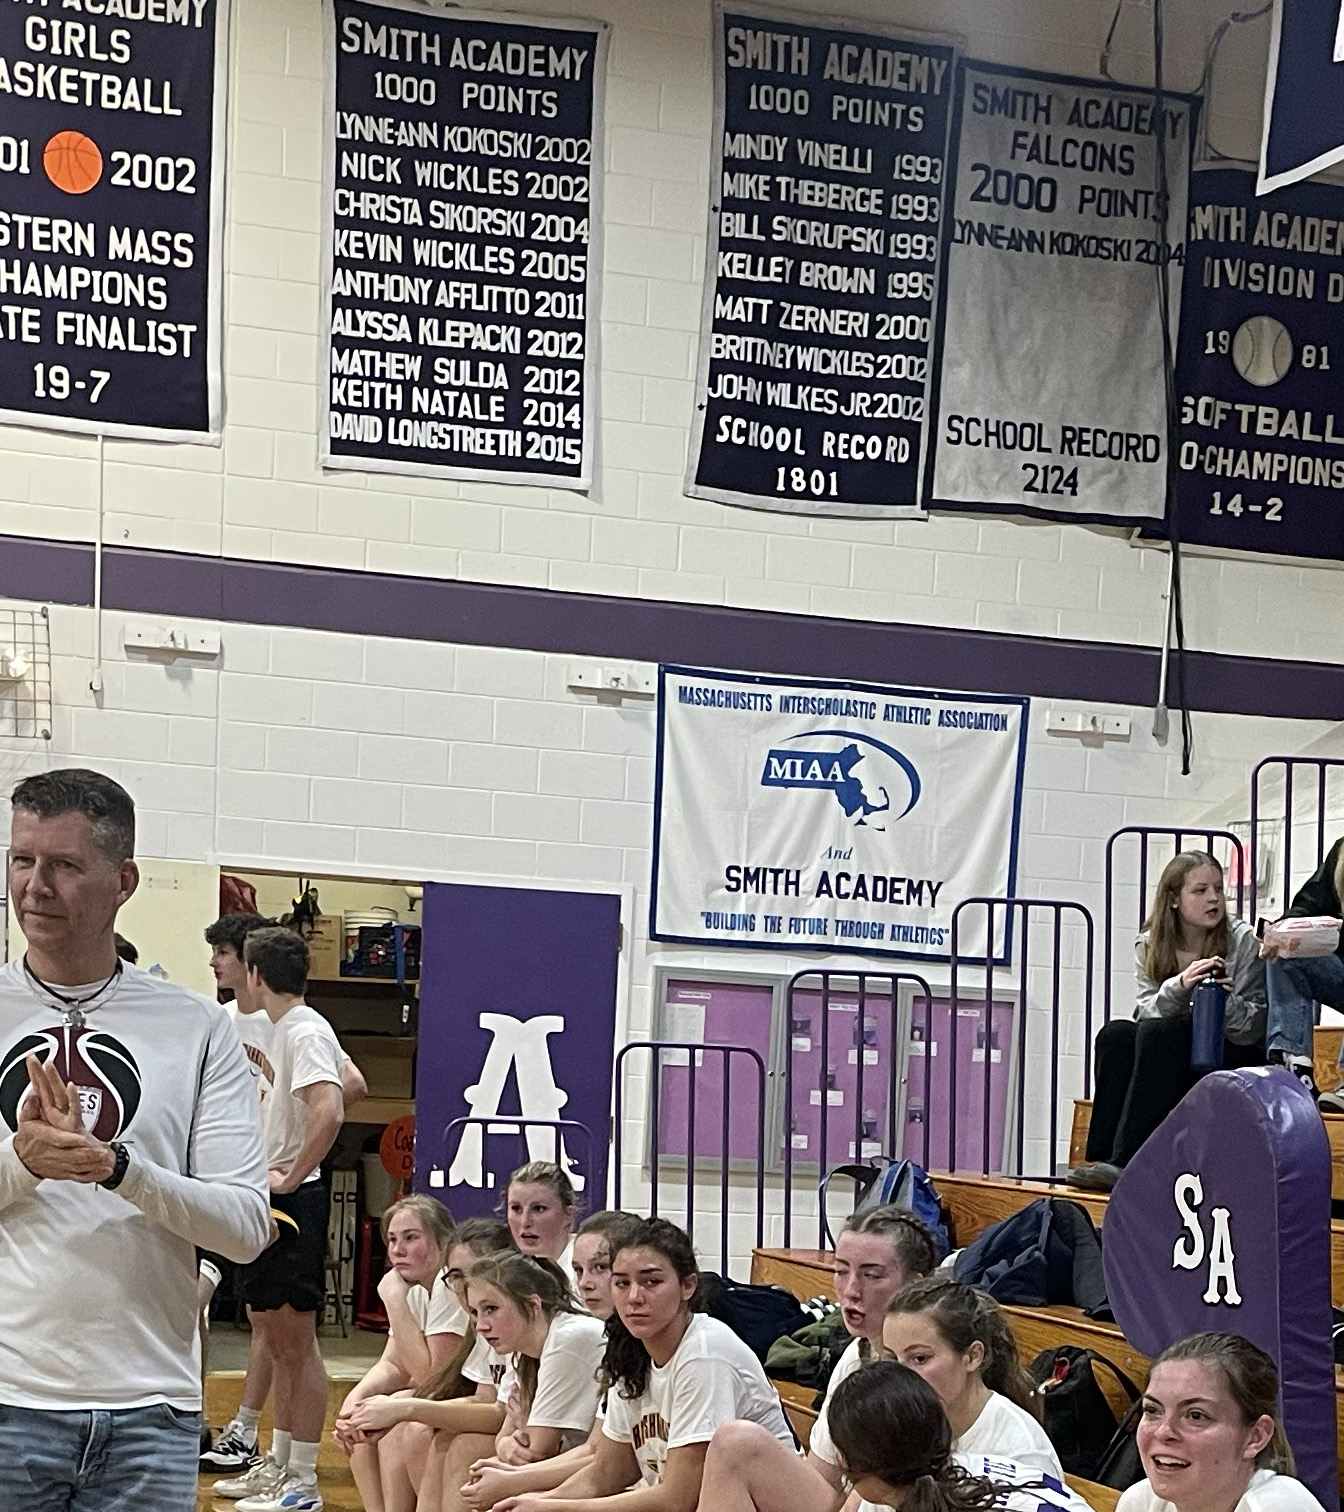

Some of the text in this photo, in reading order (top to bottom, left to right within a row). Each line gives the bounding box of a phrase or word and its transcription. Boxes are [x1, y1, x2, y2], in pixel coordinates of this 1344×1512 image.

[25, 17, 132, 64] GIRLS
[341, 16, 588, 82] SMITH ACADEMY
[727, 27, 947, 97] SMITH ACADEMY
[374, 71, 557, 118] 1000 POINTS
[749, 83, 924, 132] 1000 POINTS
[337, 111, 591, 165] LYNNE-ANN KOKOSKI 2002
[725, 131, 872, 175] MINDY VINELLI
[1011, 131, 1135, 175] FALCONS
[110, 152, 197, 195] 2002
[342, 151, 589, 203] NICK WICKLES 2002
[724, 171, 883, 216] MIKE THEBERGE
[970, 164, 1056, 213] 2000
[334, 189, 589, 244] CHRISTA SIKORSKI 2004
[721, 210, 883, 255] BILL SKORUPSKI
[109, 228, 194, 269] MASS
[334, 229, 586, 282] KEVIN WICKLES 2005
[1049, 231, 1131, 261] KOKOSKI
[331, 268, 585, 320] ANTHONY AFFLITTO 2011
[718, 250, 874, 296] KELLEY BROWN
[56, 313, 198, 358] FINALIST
[331, 308, 584, 360] ALYSSA KLEPACKI 2012
[715, 293, 931, 342] MATT ZERNERI 2000
[331, 347, 580, 396] MATHEW SULDA 2012
[711, 333, 928, 383] BRITTNEY WICKLES 2002
[33, 363, 111, 404] 19-7
[332, 378, 581, 429] KEITH NATALE 2014
[708, 372, 838, 416] JOHN WILKES
[329, 411, 581, 464] DAVID LONGSTREETH 2015
[716, 414, 910, 463] SCHOOL RECORD
[947, 415, 1160, 463] SCHOOL RECORD
[775, 466, 838, 496] 1801
[1022, 463, 1079, 496] 2124
[1209, 492, 1284, 523] 14-2
[678, 685, 1009, 732] MASSACHUSETTS INTERSCHOLASTIC ATHLETIC ASSOCIATION
[769, 758, 846, 783] MIAA
[821, 846, 854, 861] And
[726, 866, 944, 909] SMITH ACADEMY
[764, 916, 783, 934] THE
[789, 917, 828, 937] FUTURE
[835, 920, 885, 941] THROUGH
[1173, 1173, 1242, 1305] SA
